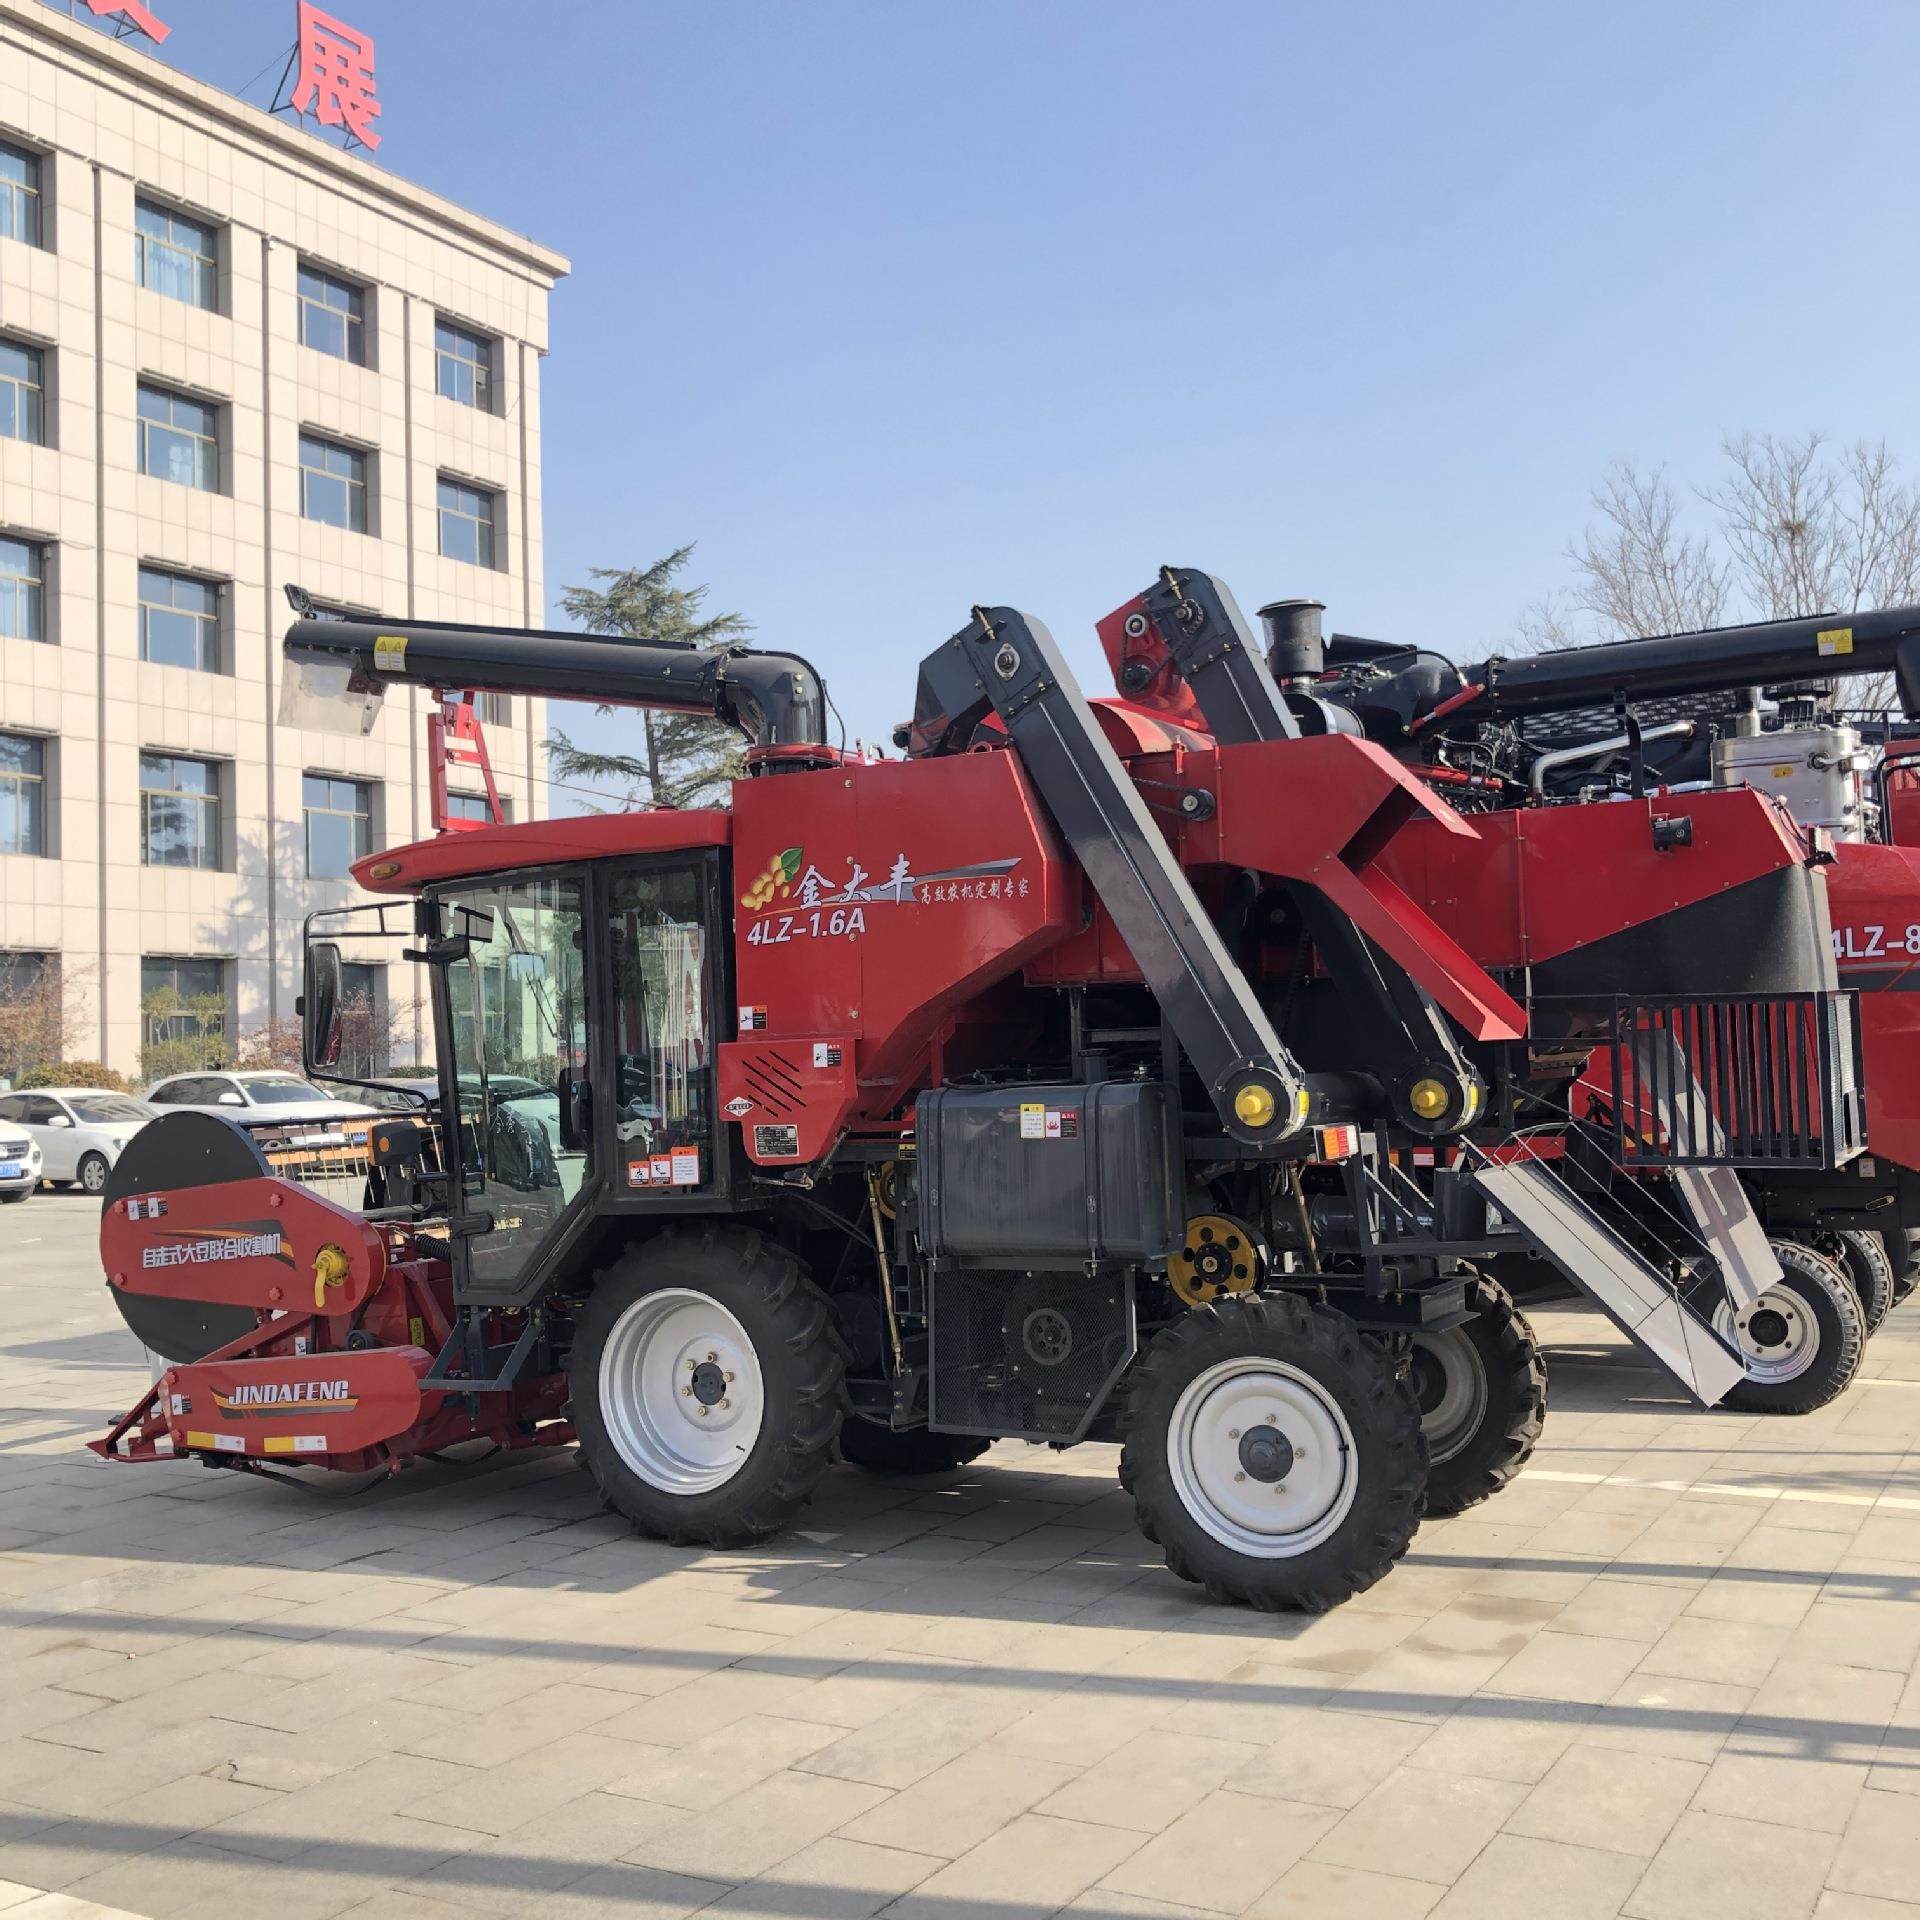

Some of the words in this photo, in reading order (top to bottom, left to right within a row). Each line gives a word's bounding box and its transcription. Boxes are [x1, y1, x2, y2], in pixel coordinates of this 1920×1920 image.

[291, 0, 382, 151] 展
[793, 853, 916, 910] 金大丰
[747, 907, 866, 946] 4LZ-1.6A
[142, 1232, 281, 1269] 自走式大豆联合收割机
[228, 1381, 349, 1405] JINDAFENG
